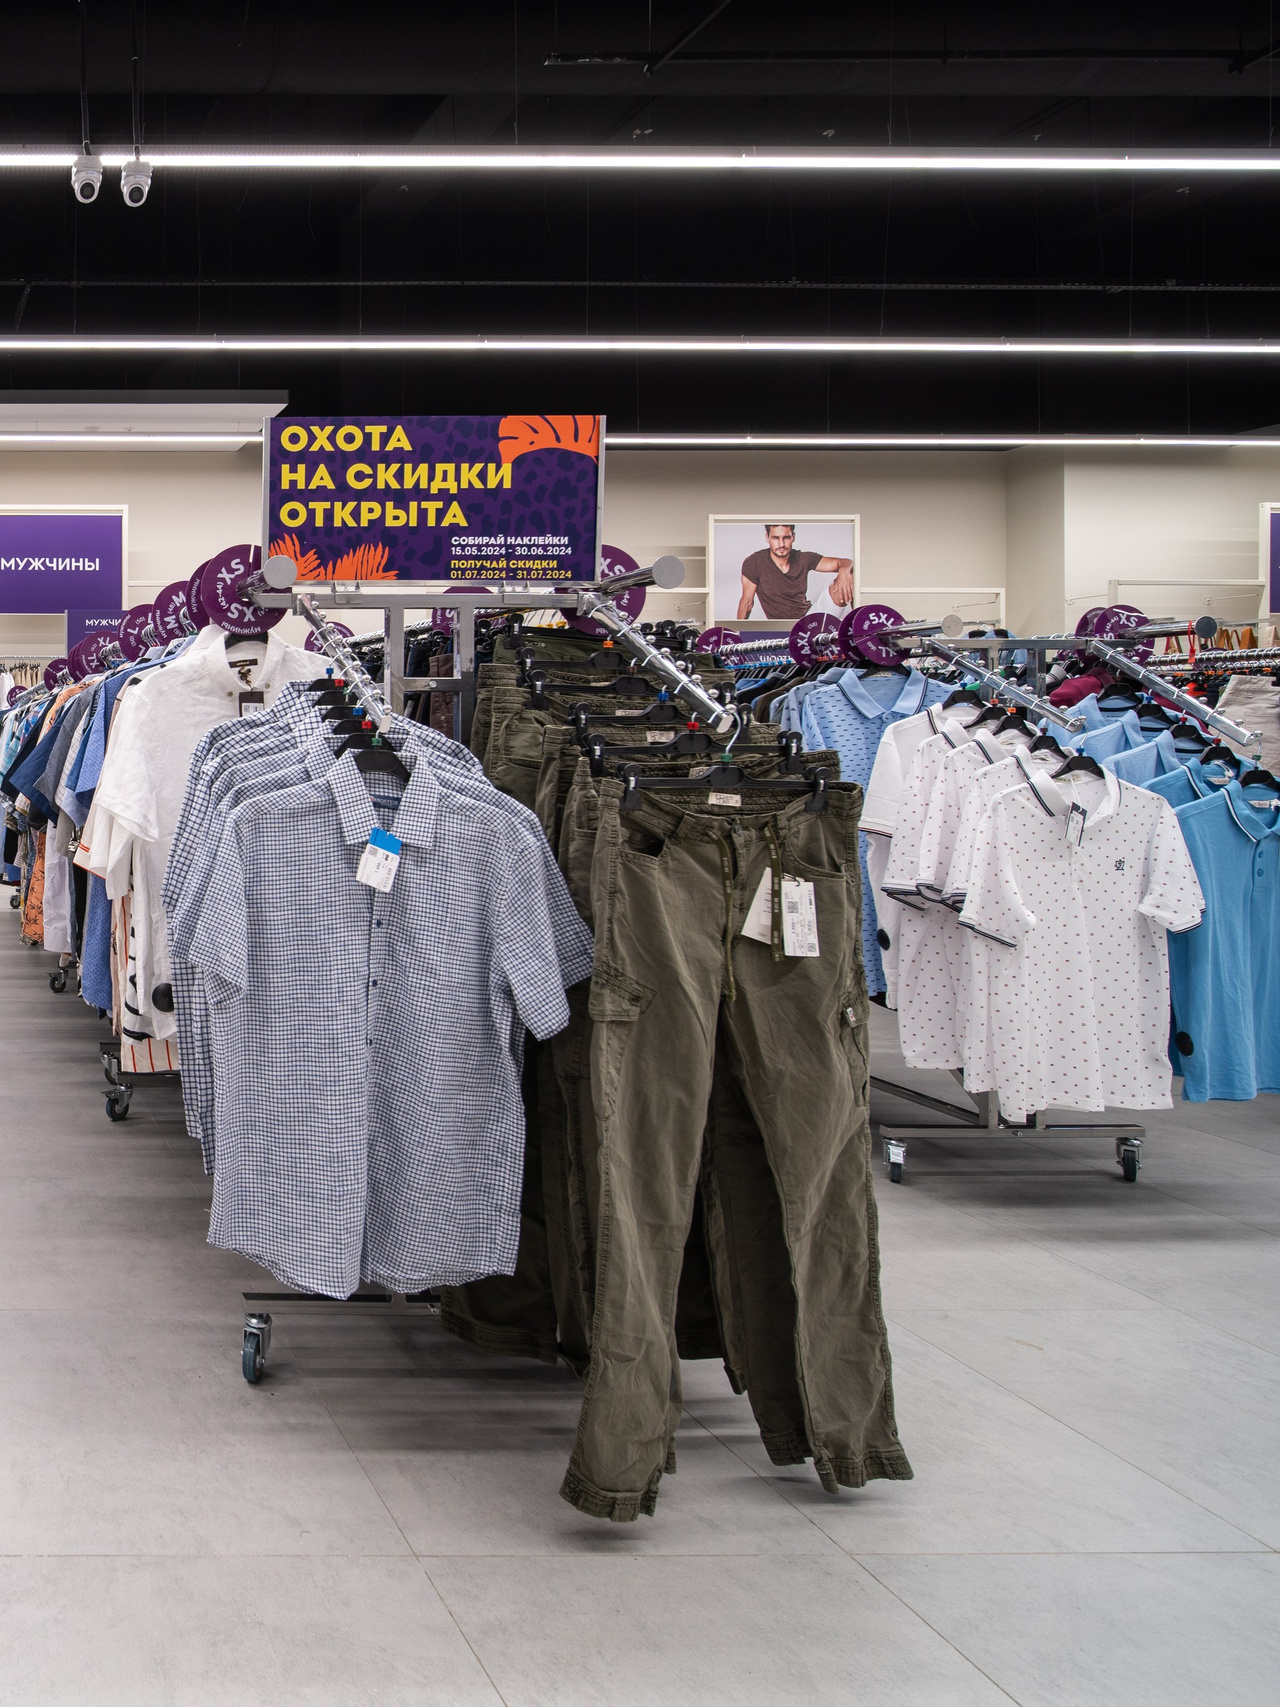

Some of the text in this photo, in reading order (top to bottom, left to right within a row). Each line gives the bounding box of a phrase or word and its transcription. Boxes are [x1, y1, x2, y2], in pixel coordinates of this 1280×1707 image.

[280, 425, 412, 452] ОХОТА
[281, 463, 512, 494] НА СКИДКИ
[280, 501, 468, 528] ОТКРЫТА
[451, 534, 569, 545] СОБИРАЙ НАКЛЕЙКИ
[451, 546, 506, 555] 15.05.2024
[515, 546, 572, 555] 30.06.2024
[0, 557, 100, 571] МУЖЧИНЫ
[450, 558, 557, 569] ПОЛУЧАЙ СКИДКИ
[216, 558, 245, 586] XS
[450, 570, 506, 579] 01.07.2024
[516, 570, 572, 579] 31.07.2024
[227, 602, 256, 622] XS
[1118, 612, 1139, 627] XS
[85, 619, 122, 627] МУЖЧИ
[868, 612, 895, 628] 5XL
[797, 631, 811, 655] 4XL
